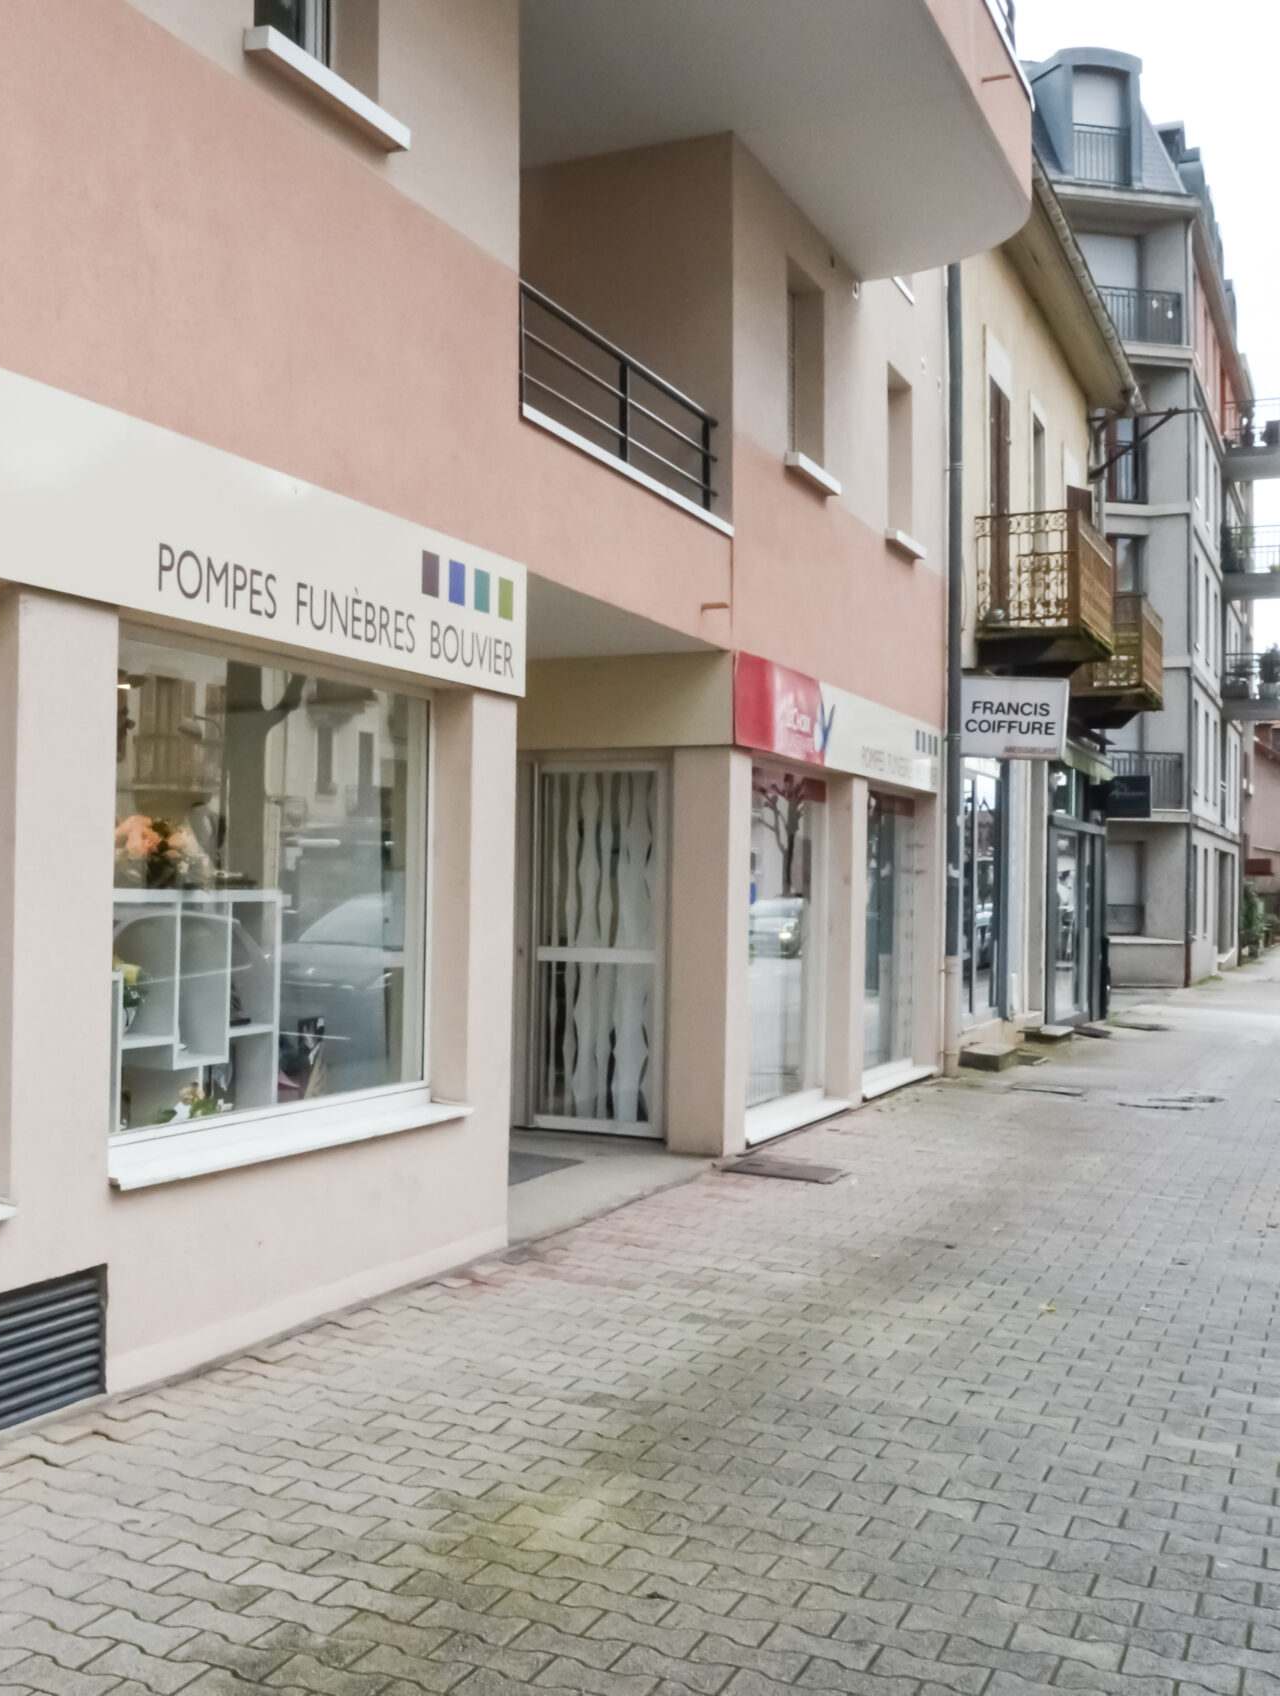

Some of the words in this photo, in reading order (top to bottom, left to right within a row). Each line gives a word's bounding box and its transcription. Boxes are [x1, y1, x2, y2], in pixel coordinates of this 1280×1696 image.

[157, 542, 278, 619] POMPES
[296, 582, 416, 654] FUNÈBRES
[429, 620, 515, 679] BOUVIER
[971, 700, 1051, 717] FRANCIS
[964, 718, 1057, 736] COIFFURE
